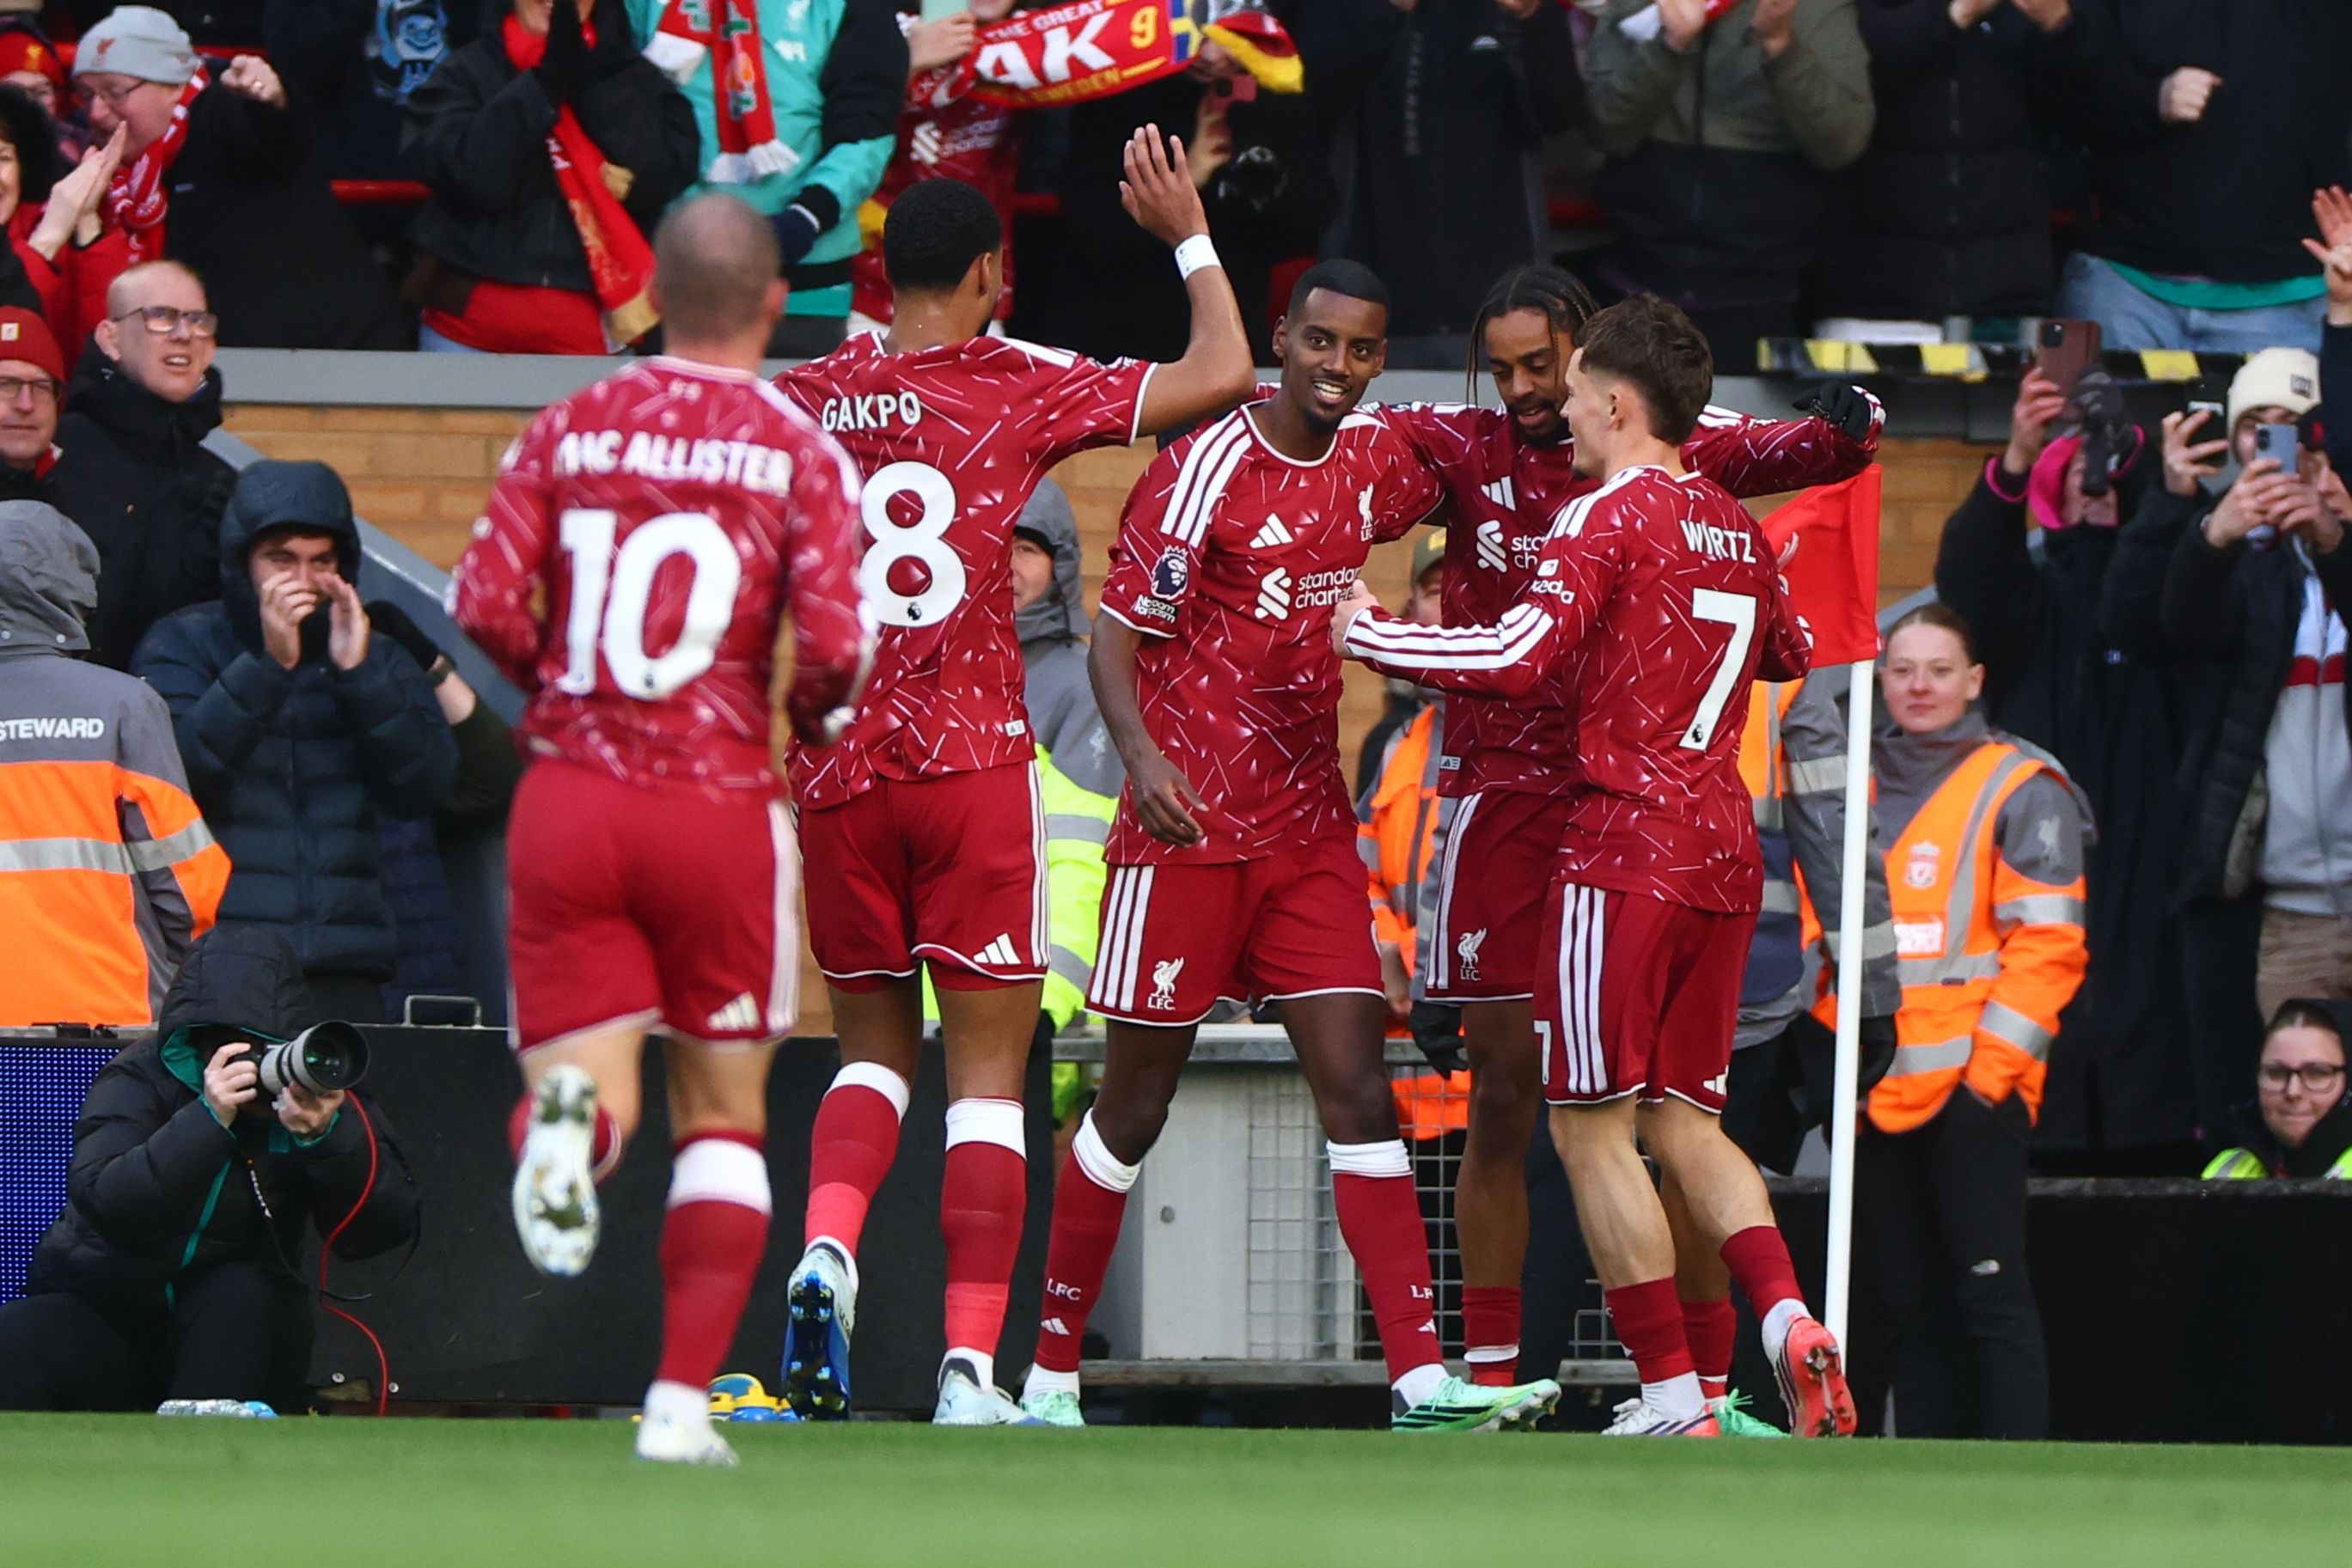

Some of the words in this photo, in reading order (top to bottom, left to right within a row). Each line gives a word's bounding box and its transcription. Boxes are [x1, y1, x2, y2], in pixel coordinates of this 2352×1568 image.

[985, 21, 1032, 40] THE
[1033, 0, 1103, 31] GREAT
[1130, 5, 1158, 50] 9
[821, 390, 921, 432] GAKPO
[621, 430, 794, 498] ALLISTER
[860, 460, 967, 628] 8
[1679, 519, 1757, 564] WIRTZ
[555, 507, 742, 701] 10
[1677, 587, 1757, 752] 7
[1533, 1020, 1552, 1085] 7
[1048, 1278, 1082, 1301] LFC
[1409, 1284, 1434, 1299] LF
